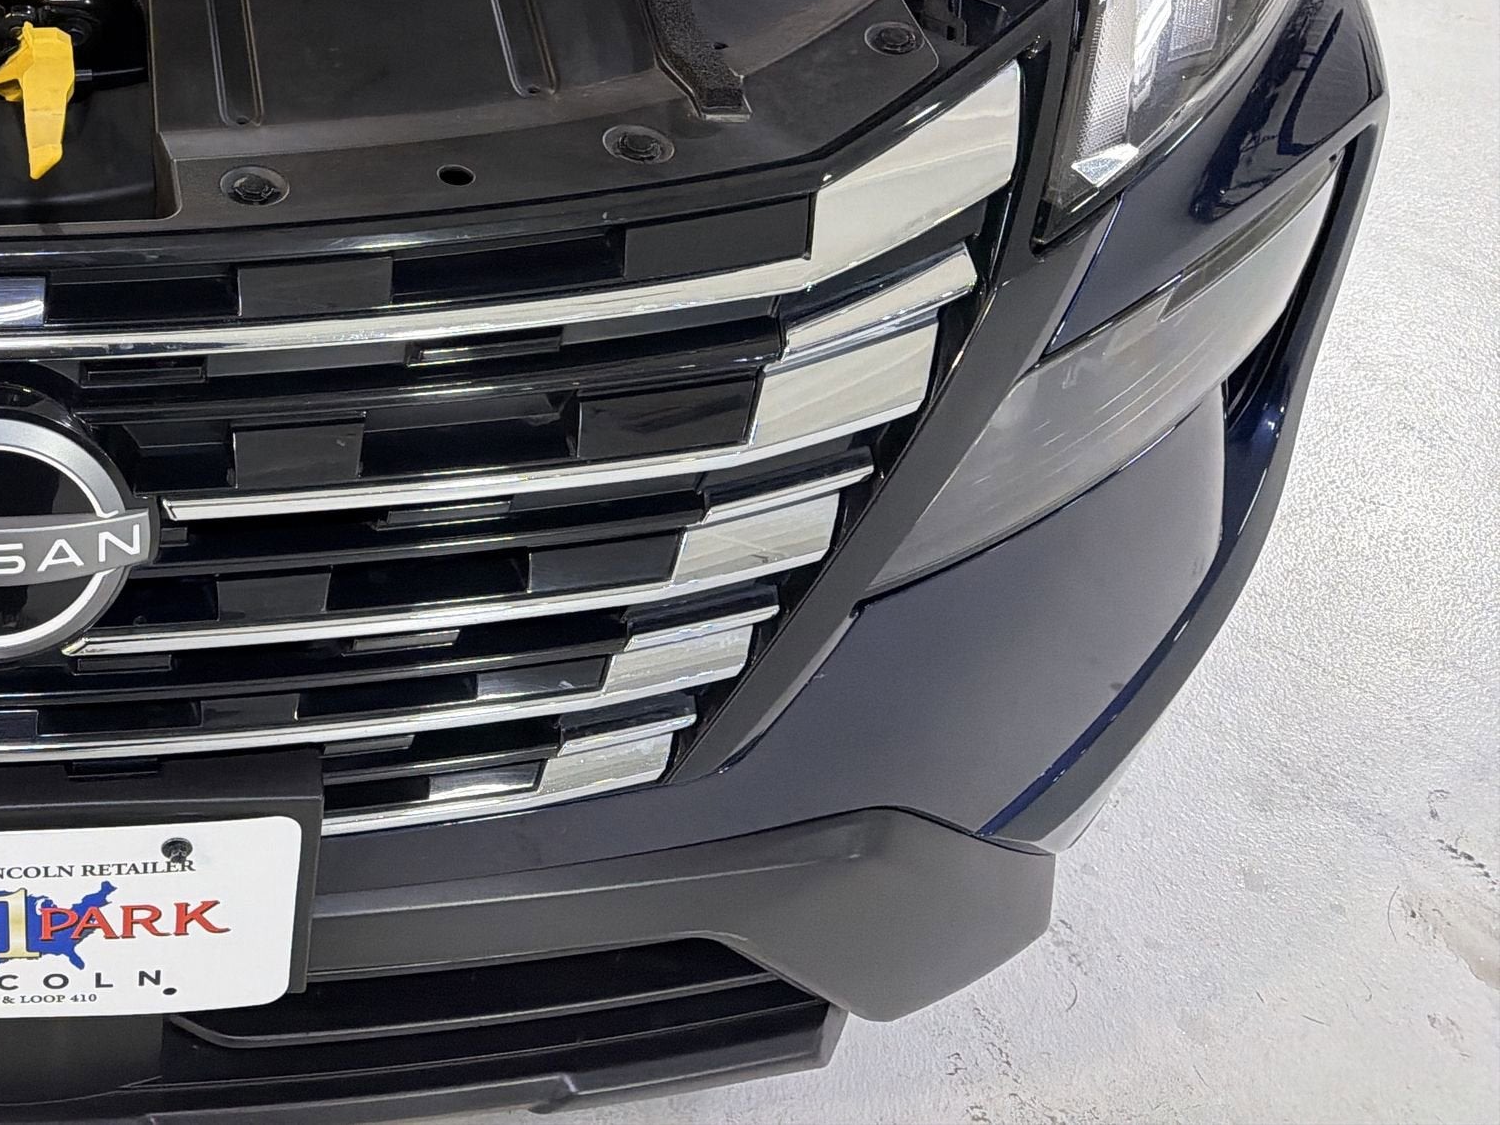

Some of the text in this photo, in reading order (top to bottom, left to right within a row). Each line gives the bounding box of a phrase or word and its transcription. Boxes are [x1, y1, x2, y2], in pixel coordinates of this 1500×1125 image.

[81, 859, 197, 877] RETAILER
[39, 899, 232, 942] PARK
[2, 994, 16, 1005] &
[19, 993, 66, 1005] LOOP
[69, 992, 98, 1003] 410
